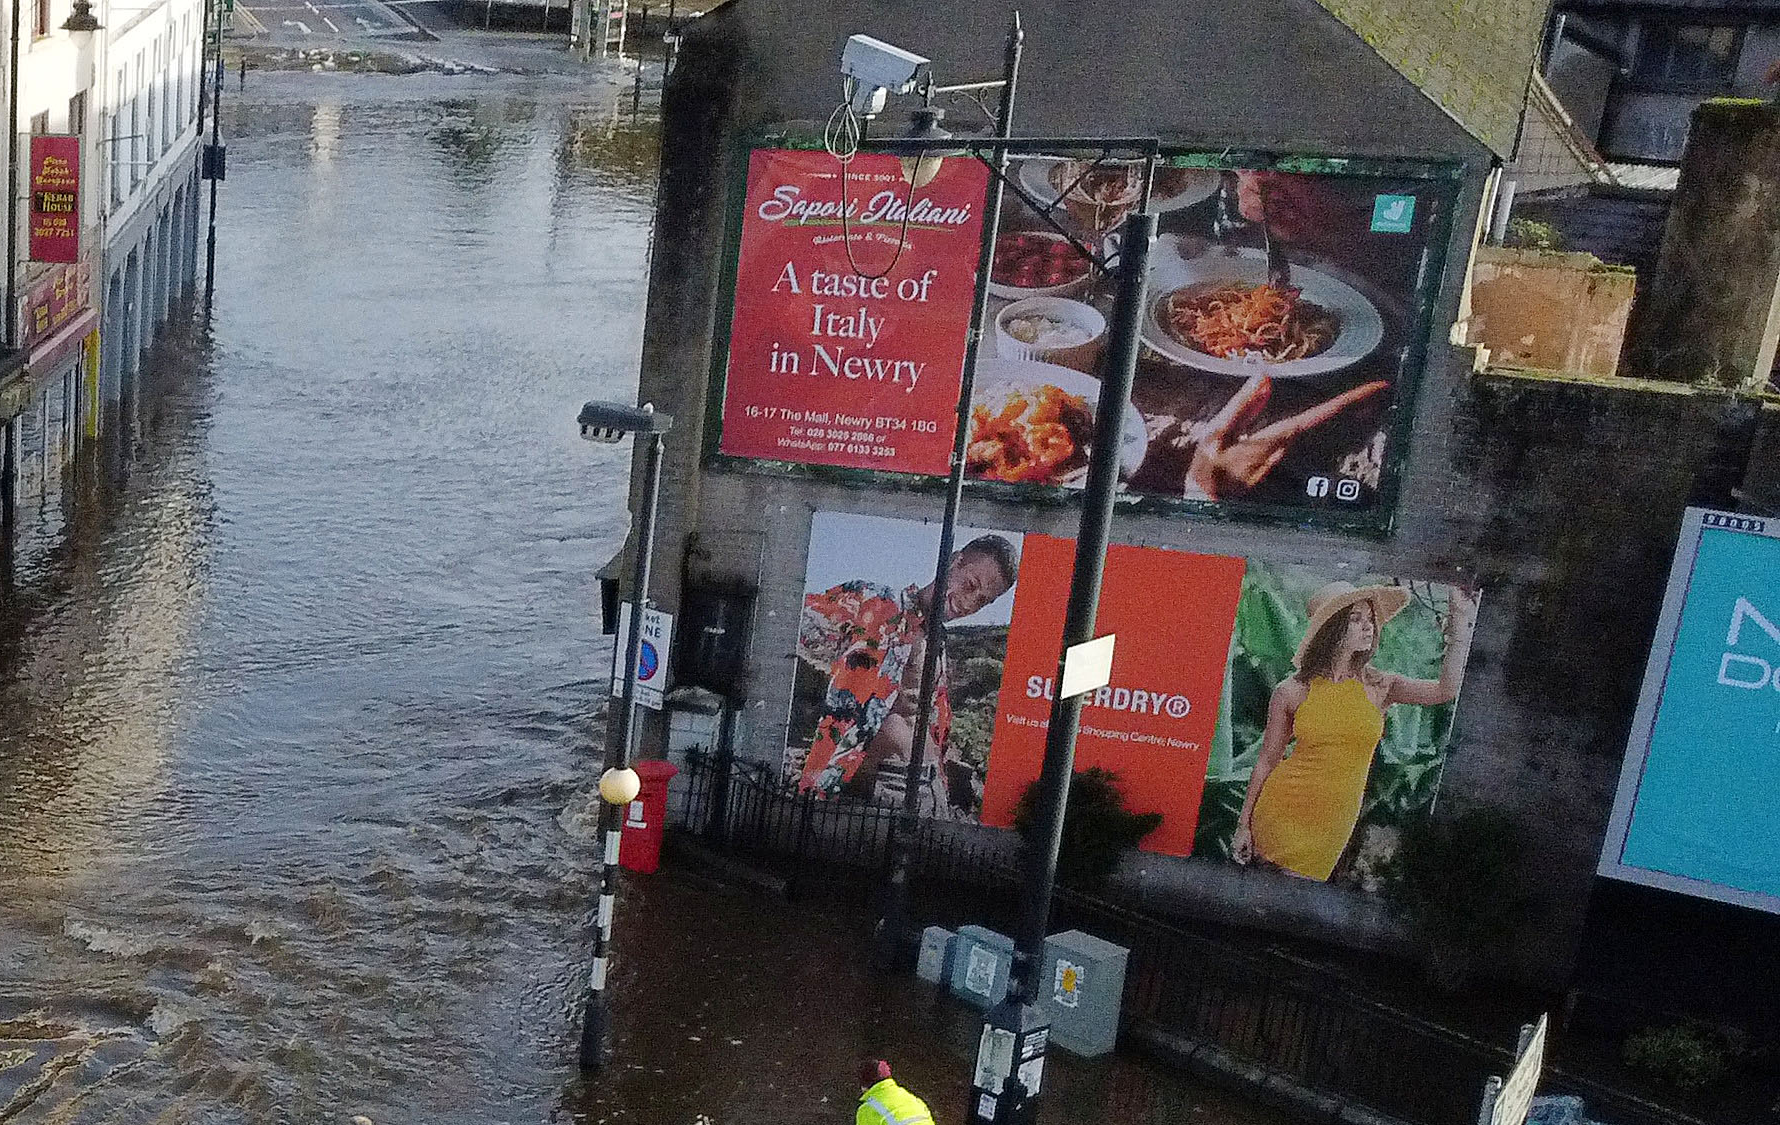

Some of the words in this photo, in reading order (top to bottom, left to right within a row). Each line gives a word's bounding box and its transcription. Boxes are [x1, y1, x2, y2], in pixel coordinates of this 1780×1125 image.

[758, 184, 859, 225] Sapori
[860, 191, 972, 226] Italiani
[771, 260, 802, 294] A
[811, 269, 890, 299] taste
[896, 268, 938, 302] of
[810, 303, 886, 350] Italy
[769, 341, 800, 374] in
[809, 344, 927, 394] Newry
[744, 404, 777, 420] 16-17
[780, 407, 802, 421] The
[804, 410, 832, 426] Mall,
[834, 413, 872, 430] Newry
